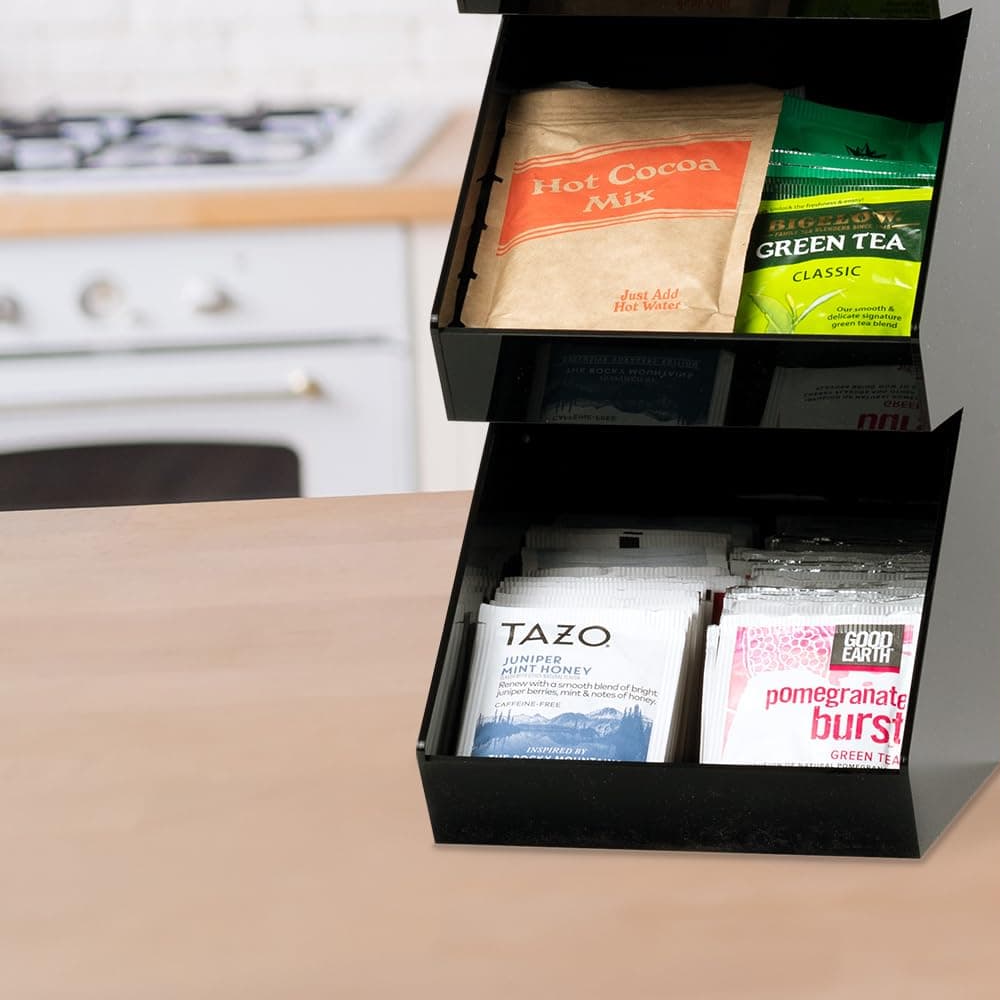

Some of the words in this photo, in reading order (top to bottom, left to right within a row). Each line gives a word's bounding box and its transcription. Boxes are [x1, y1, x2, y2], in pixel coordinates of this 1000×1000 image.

[531, 173, 600, 196] Hot
[608, 158, 721, 186] Cocoa
[582, 189, 656, 213] Mix
[768, 210, 901, 232] BIGELOW
[756, 234, 846, 259] GREEN
[852, 232, 906, 251] TEA
[792, 265, 862, 283] CLASSIC
[620, 289, 648, 301] Just
[651, 288, 680, 300] Add
[613, 301, 640, 313] Hot
[643, 300, 681, 311] Water
[827, 313, 860, 321] delicate
[862, 313, 902, 322] signature
[831, 321, 856, 329] green
[873, 320, 898, 329] blend
[501, 622, 611, 648] TAZO
[844, 631, 893, 648] GOOD
[503, 655, 562, 666] JUNIPER
[842, 647, 893, 663] EARTH
[501, 664, 537, 676] MINT
[540, 665, 592, 676] HONEY
[495, 688, 526, 698] juniper
[527, 687, 559, 696] berries,
[560, 689, 582, 697] mint
[591, 691, 616, 699] notes
[617, 691, 628, 699] of
[629, 693, 657, 706] honey.
[498, 680, 528, 688] Renew
[558, 681, 592, 690] smooth
[594, 682, 619, 691] blend
[631, 684, 658, 697] bright
[494, 700, 561, 708] CAFFEINE-FREE
[765, 686, 907, 710] pomegranate
[810, 705, 904, 745] burst
[526, 746, 573, 754] INSPIRED
[830, 750, 873, 762] GREEN
[877, 752, 901, 766] TEA
